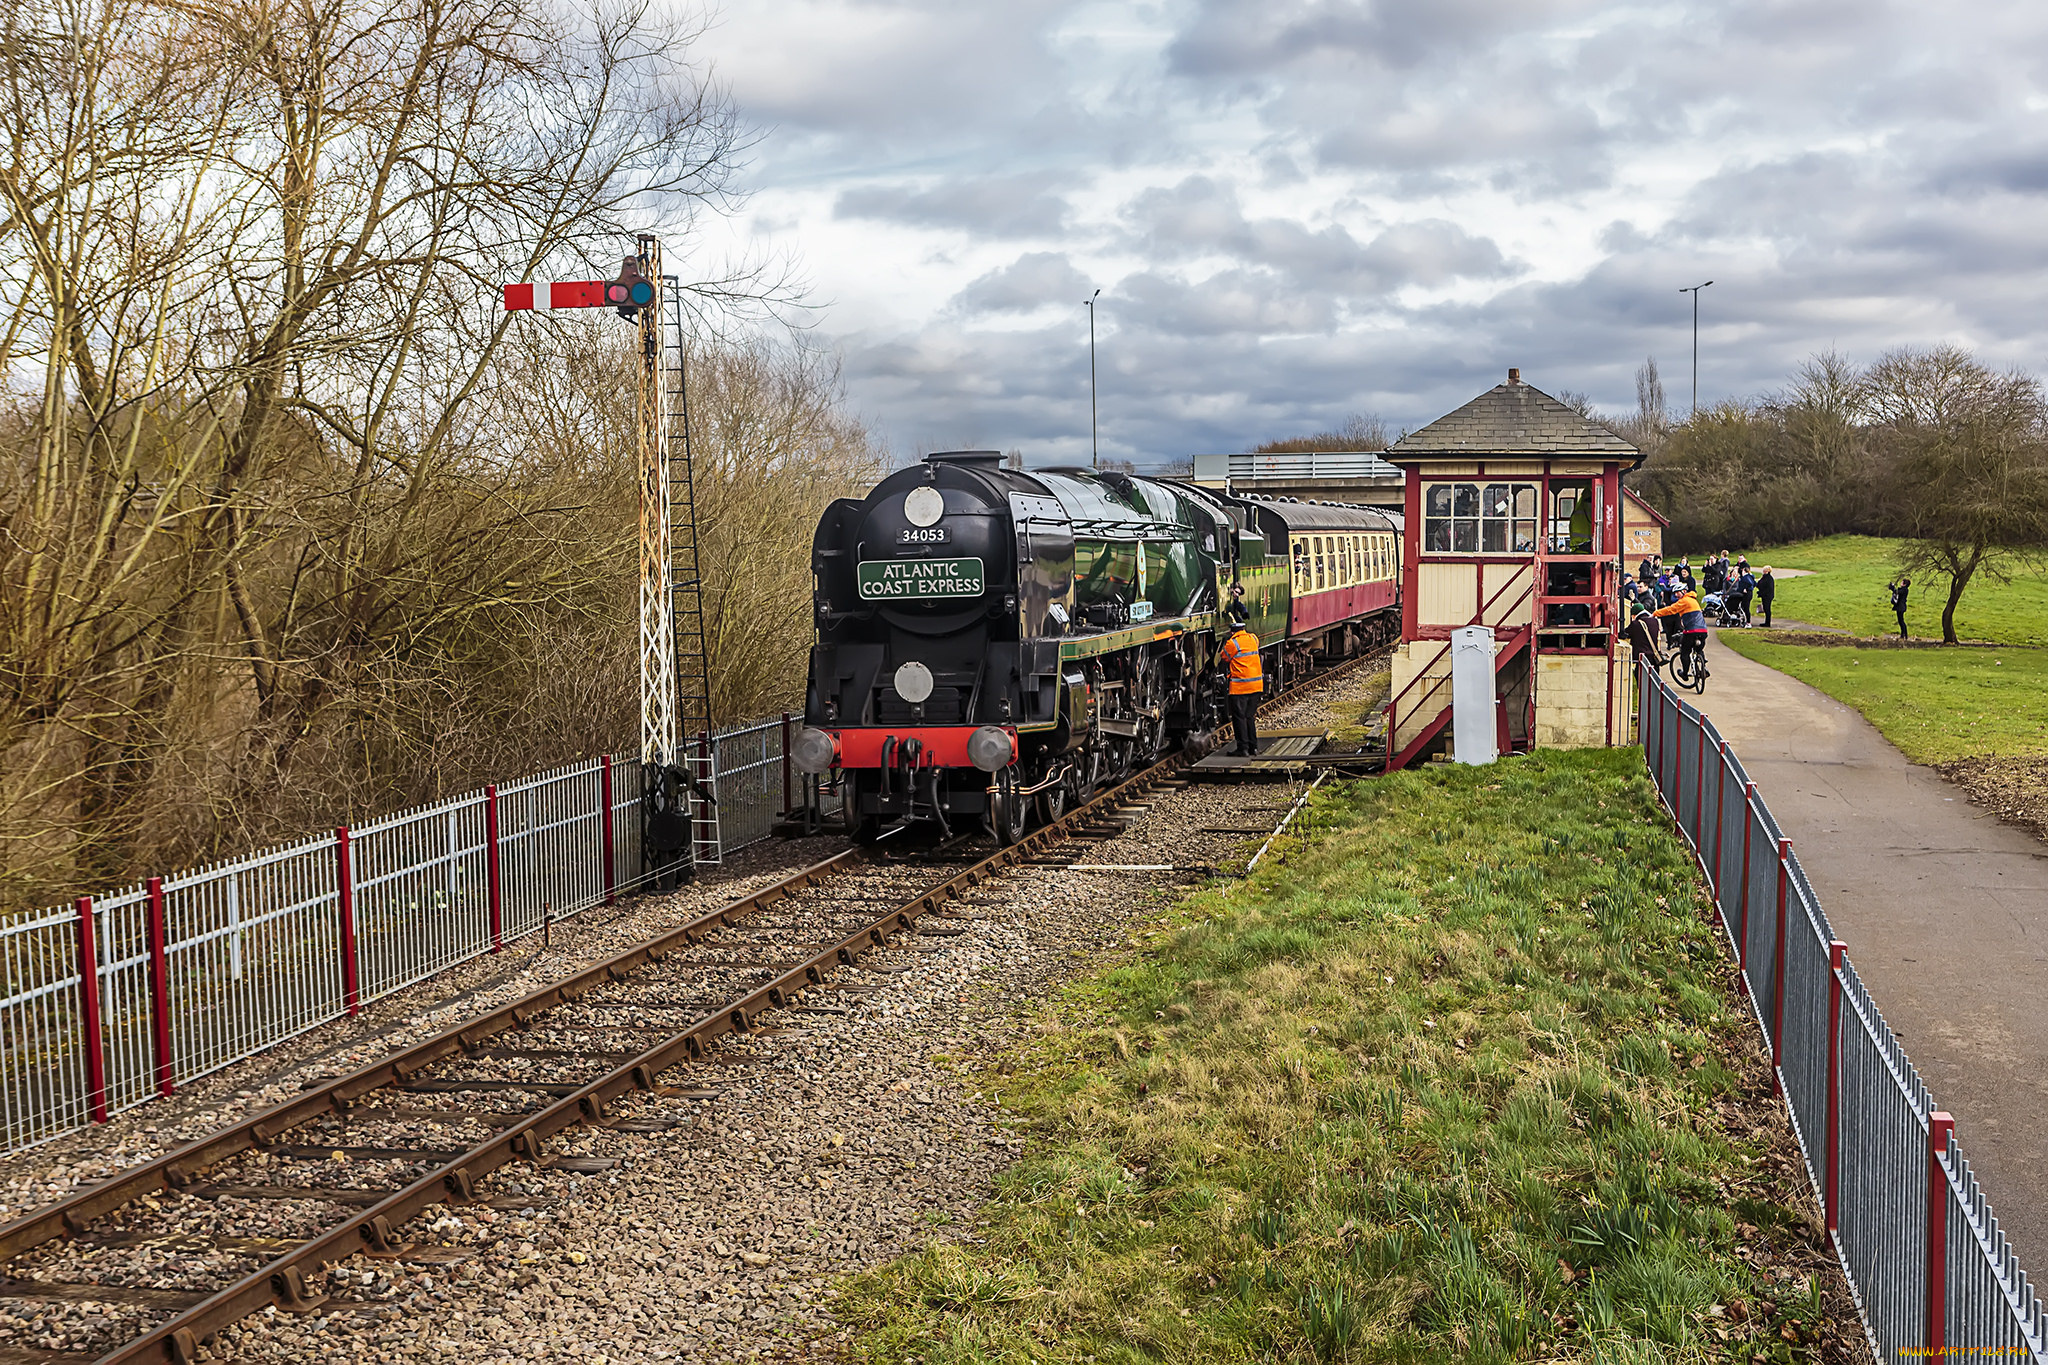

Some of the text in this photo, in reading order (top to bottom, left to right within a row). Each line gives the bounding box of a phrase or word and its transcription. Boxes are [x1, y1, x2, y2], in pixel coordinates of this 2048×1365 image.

[902, 529, 945, 542] 34053
[883, 562, 959, 579] ATLANTIC
[862, 578, 981, 595] COAST EXPRESS
